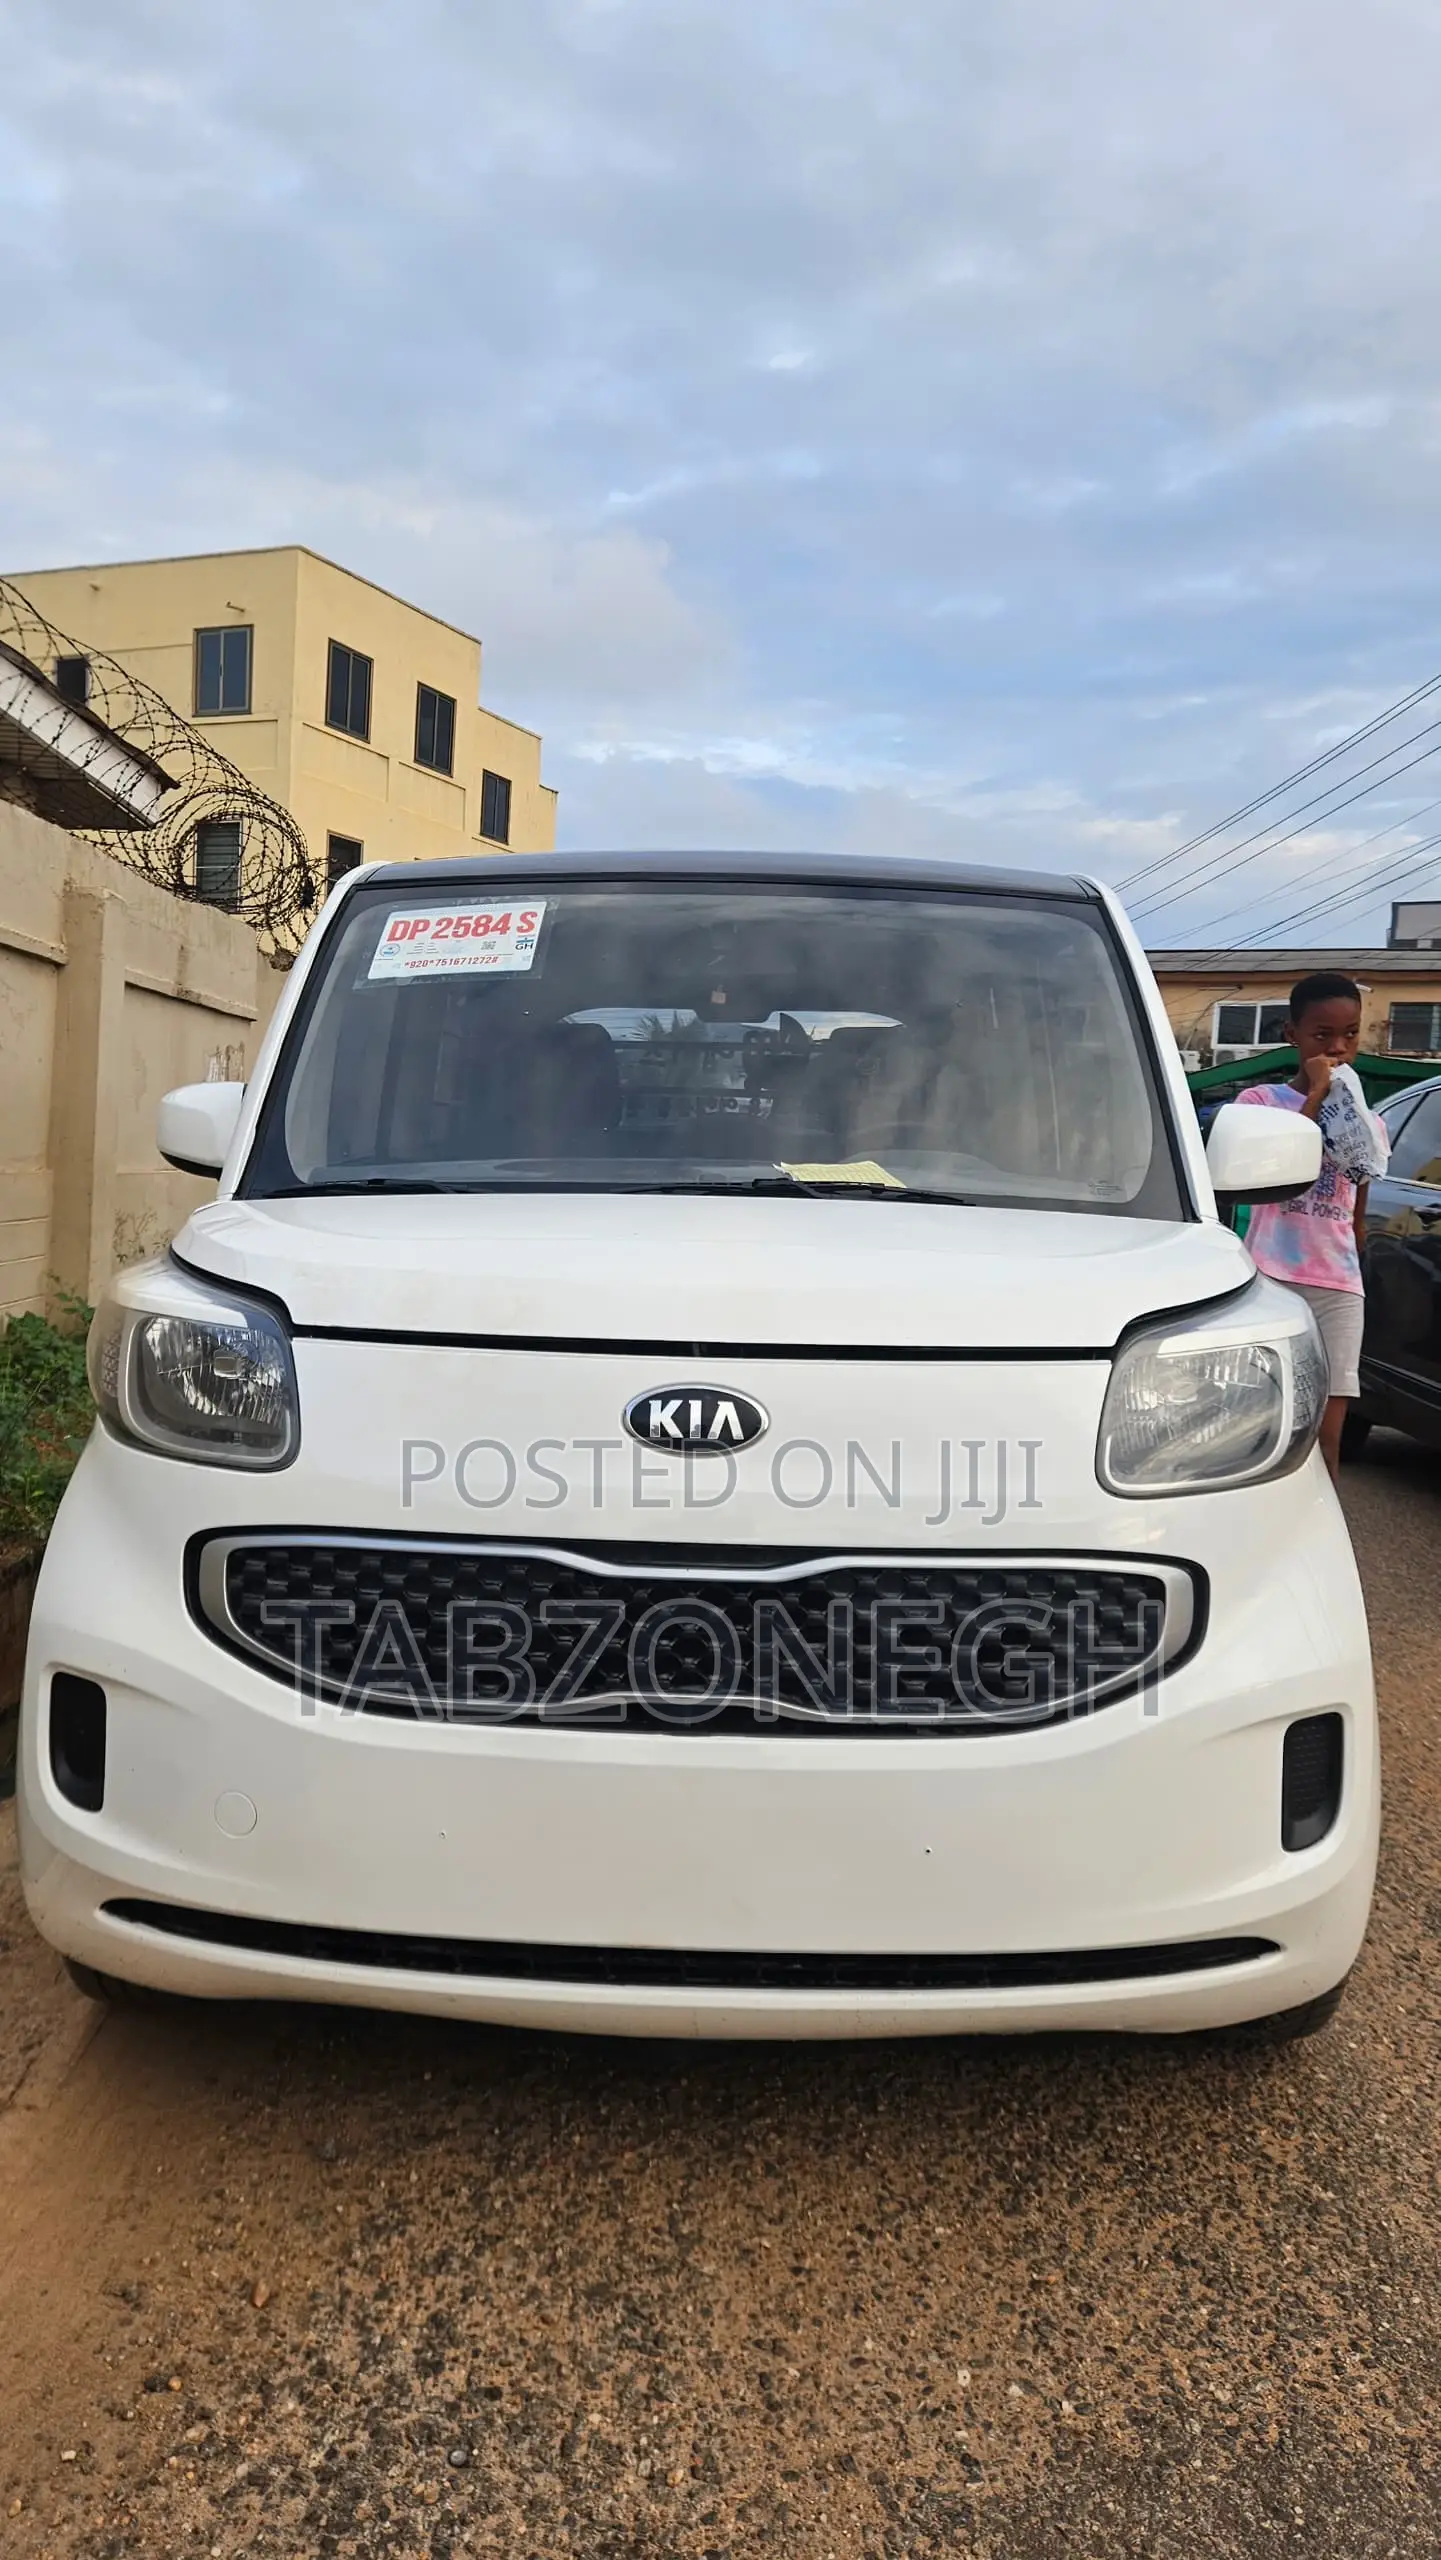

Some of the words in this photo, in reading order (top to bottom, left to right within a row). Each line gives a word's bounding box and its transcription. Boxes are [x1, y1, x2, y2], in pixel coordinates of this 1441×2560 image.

[387, 918, 431, 942] DP
[431, 912, 513, 940] 2584
[516, 911, 538, 934] S
[515, 943, 534, 951] GH
[648, 1399, 744, 1440] KIA
